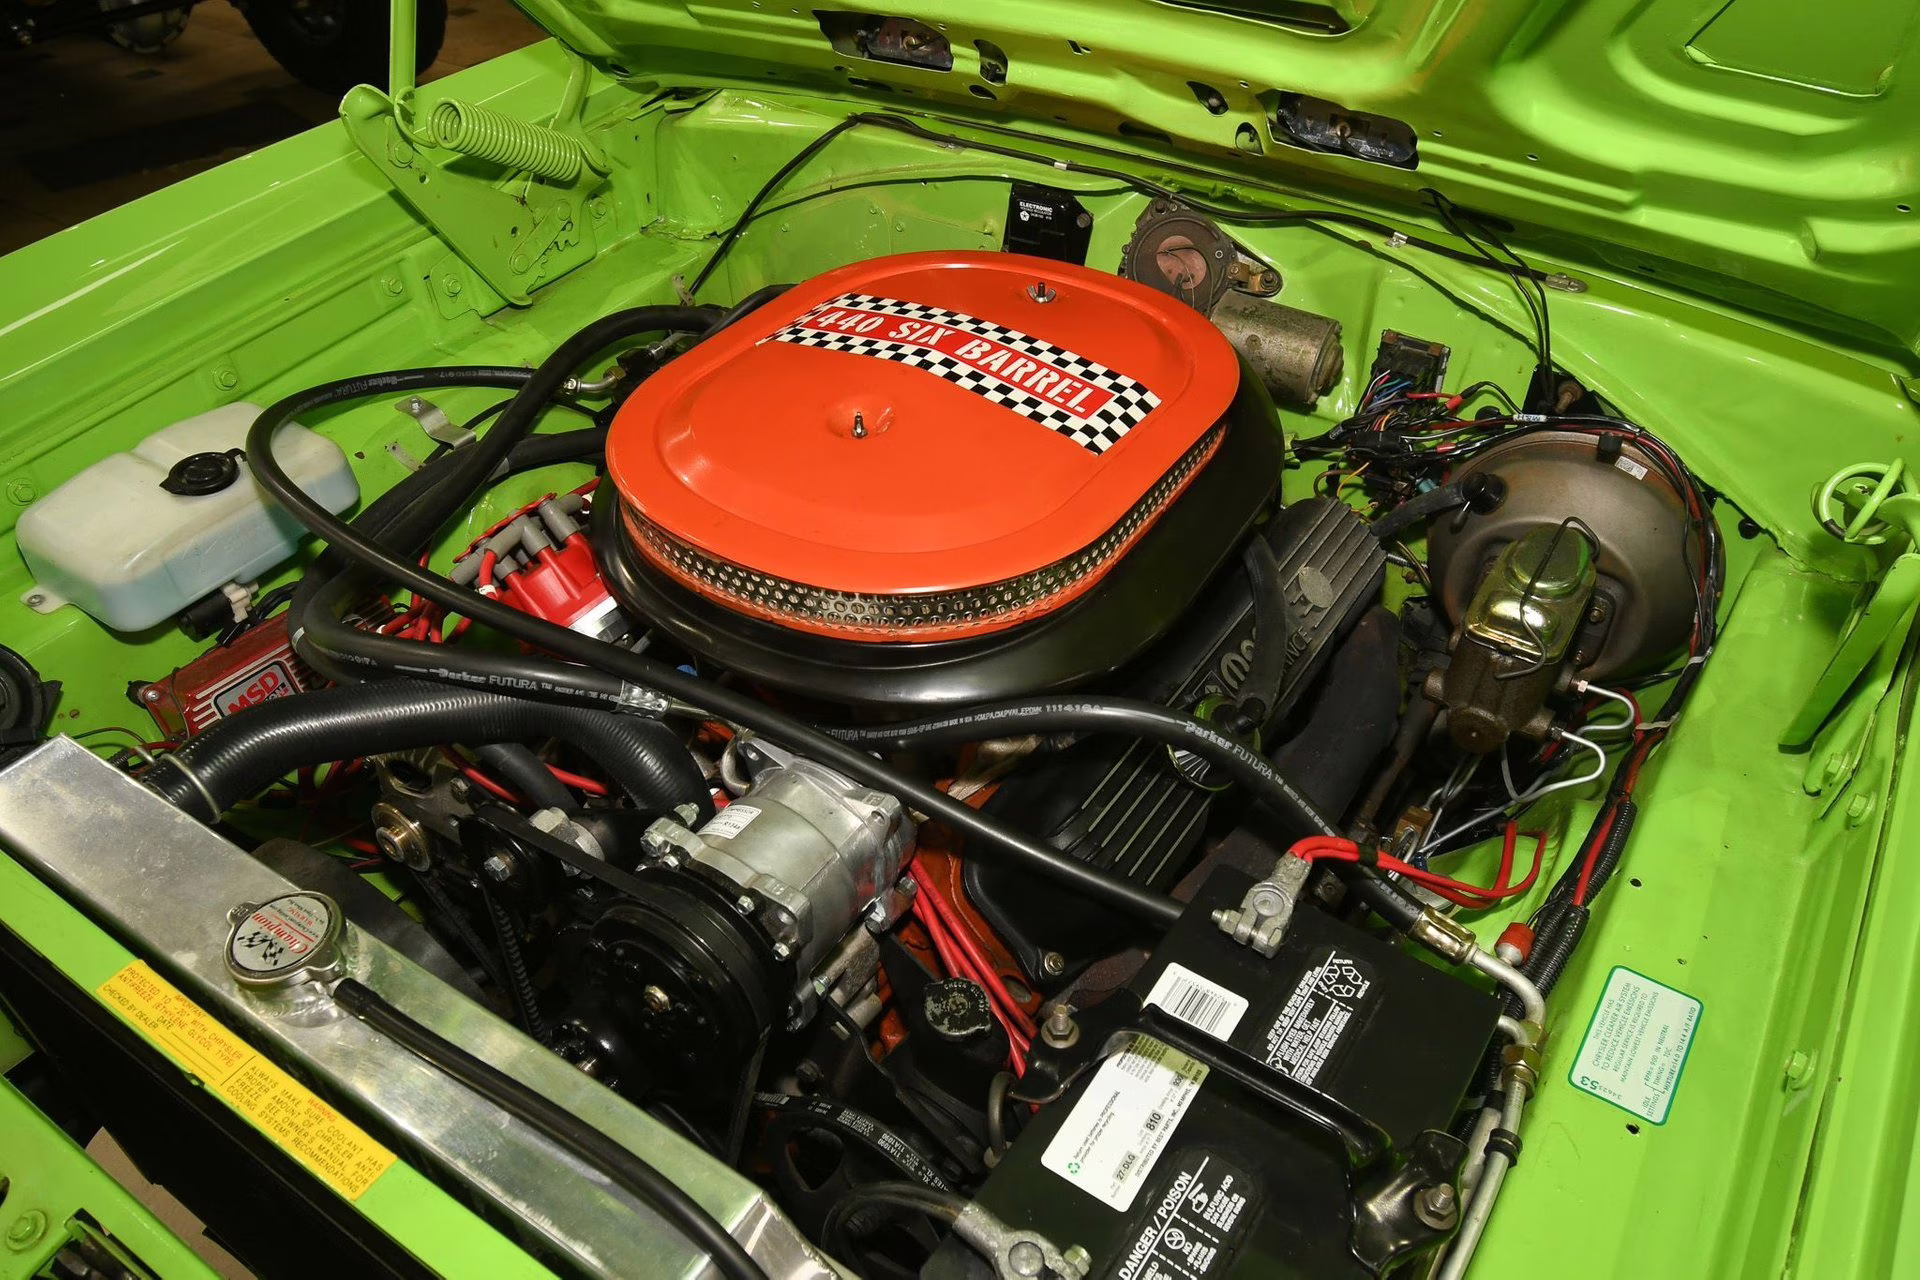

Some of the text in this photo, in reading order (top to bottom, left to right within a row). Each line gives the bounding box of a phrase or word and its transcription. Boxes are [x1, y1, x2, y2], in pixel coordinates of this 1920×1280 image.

[1019, 201, 1052, 212] ELECTRONIC
[815, 309, 1098, 414] 440 SIX BARREL
[227, 670, 280, 714] MSD
[439, 668, 537, 690] Parker FUTURA
[1186, 721, 1273, 780] Parker FUTURA
[251, 912, 308, 954] Champion
[103, 984, 157, 1030] CHECKED BY DEALER
[117, 974, 151, 1002] ANTIFREEZE
[188, 1029, 211, 1050] GLYCOL
[125, 966, 159, 995] PROTECTED
[161, 995, 170, 1004] TO
[191, 1019, 207, 1032] WITH
[209, 1032, 241, 1059] CHRYSLER
[157, 1015, 172, 1030] DATE
[1276, 998, 1315, 1057] FLUSH EYES IMMEDIATELY
[1592, 982, 1631, 1066] CHRYSLER CLEANER AIR SYSTEM
[1600, 985, 1640, 1070] TO REDUCE VEHICLE EMISSIONS
[1283, 1020, 1311, 1061] WITH GET
[1289, 1043, 1305, 1064] MEDICAL
[1302, 1030, 1313, 1043] HELP
[1310, 1018, 1320, 1031] FAST
[1612, 1049, 1625, 1071] REGULAR
[1621, 1028, 1633, 1048] SERVICE
[1631, 1000, 1644, 1023] REQUIRED
[1640, 992, 1647, 1000] TO
[1619, 991, 1658, 1082] MAINTAIN LOWEST VEHICLE EMISSIONS
[1657, 1024, 1669, 1045] NEUTRAL
[1580, 1075, 1599, 1091] 53
[1646, 1092, 1660, 1117] SETTINGS
[234, 1078, 260, 1101] FREEZE
[265, 1102, 279, 1115] SEE
[317, 1144, 348, 1170] MANUAL
[351, 1170, 368, 1186] FOR
[242, 1072, 268, 1094] PROPER
[271, 1094, 299, 1119] AMOUNT
[302, 1119, 312, 1129] OF
[315, 1129, 352, 1160] CHRYSLER
[250, 1065, 383, 1171] ALWAYS MAKE SURE COOLANT HAS
[307, 1098, 336, 1122] WARNING
[1146, 1112, 1161, 1131] 810
[227, 1085, 359, 1193] COOLING SYSTEMS RECOMMENDATIONS
[877, 1138, 901, 1157] 11A1090
[881, 1132, 905, 1152] 11A1090
[1202, 1174, 1234, 1220] SULFURIC ACID
[1117, 1170, 1192, 1280] DANGER POISON
[1182, 1242, 1193, 1254] NO
